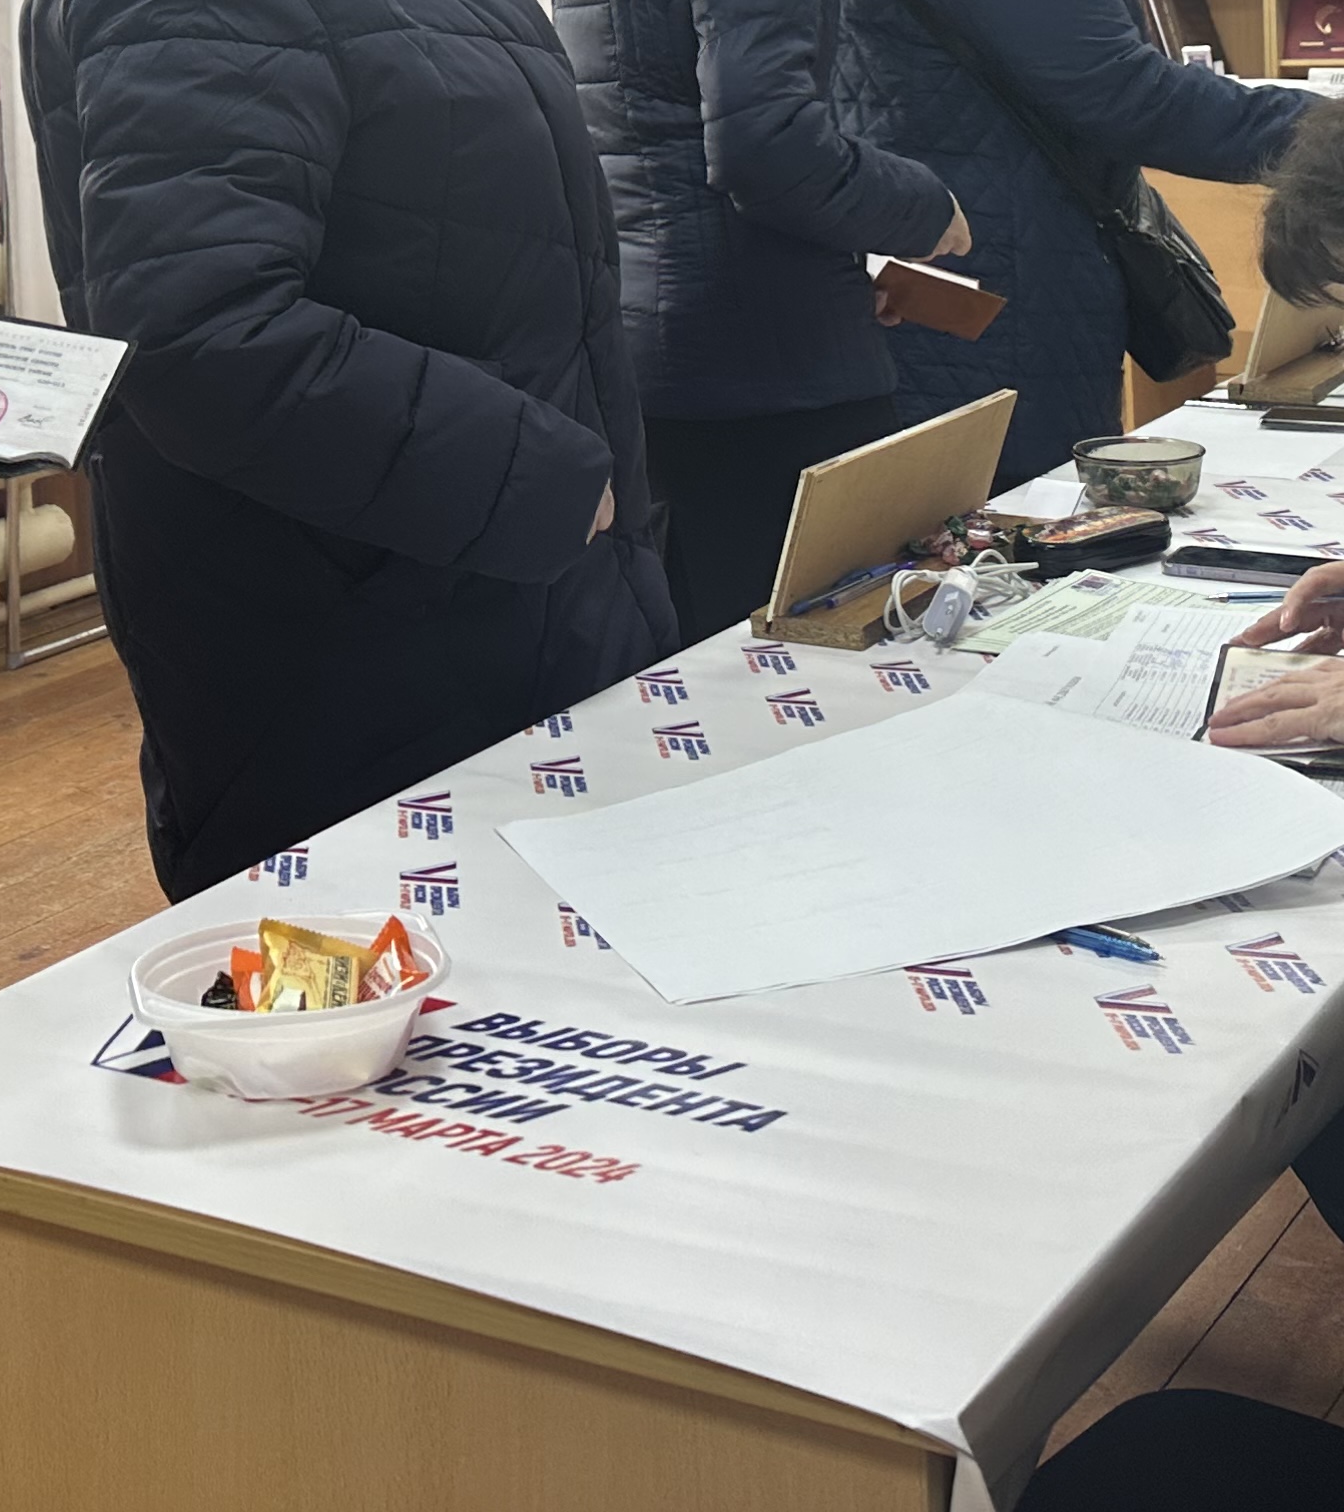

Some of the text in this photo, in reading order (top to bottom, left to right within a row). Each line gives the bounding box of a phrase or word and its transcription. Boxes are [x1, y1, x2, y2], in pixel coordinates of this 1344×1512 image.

[450, 1011, 749, 1081] ВЫБОРЫ
[360, 1067, 571, 1125] ССИИ
[404, 1034, 789, 1133] ПРЕЗИДЕНТА
[344, 1107, 524, 1158] МАРТА
[501, 1144, 643, 1184] 2024
